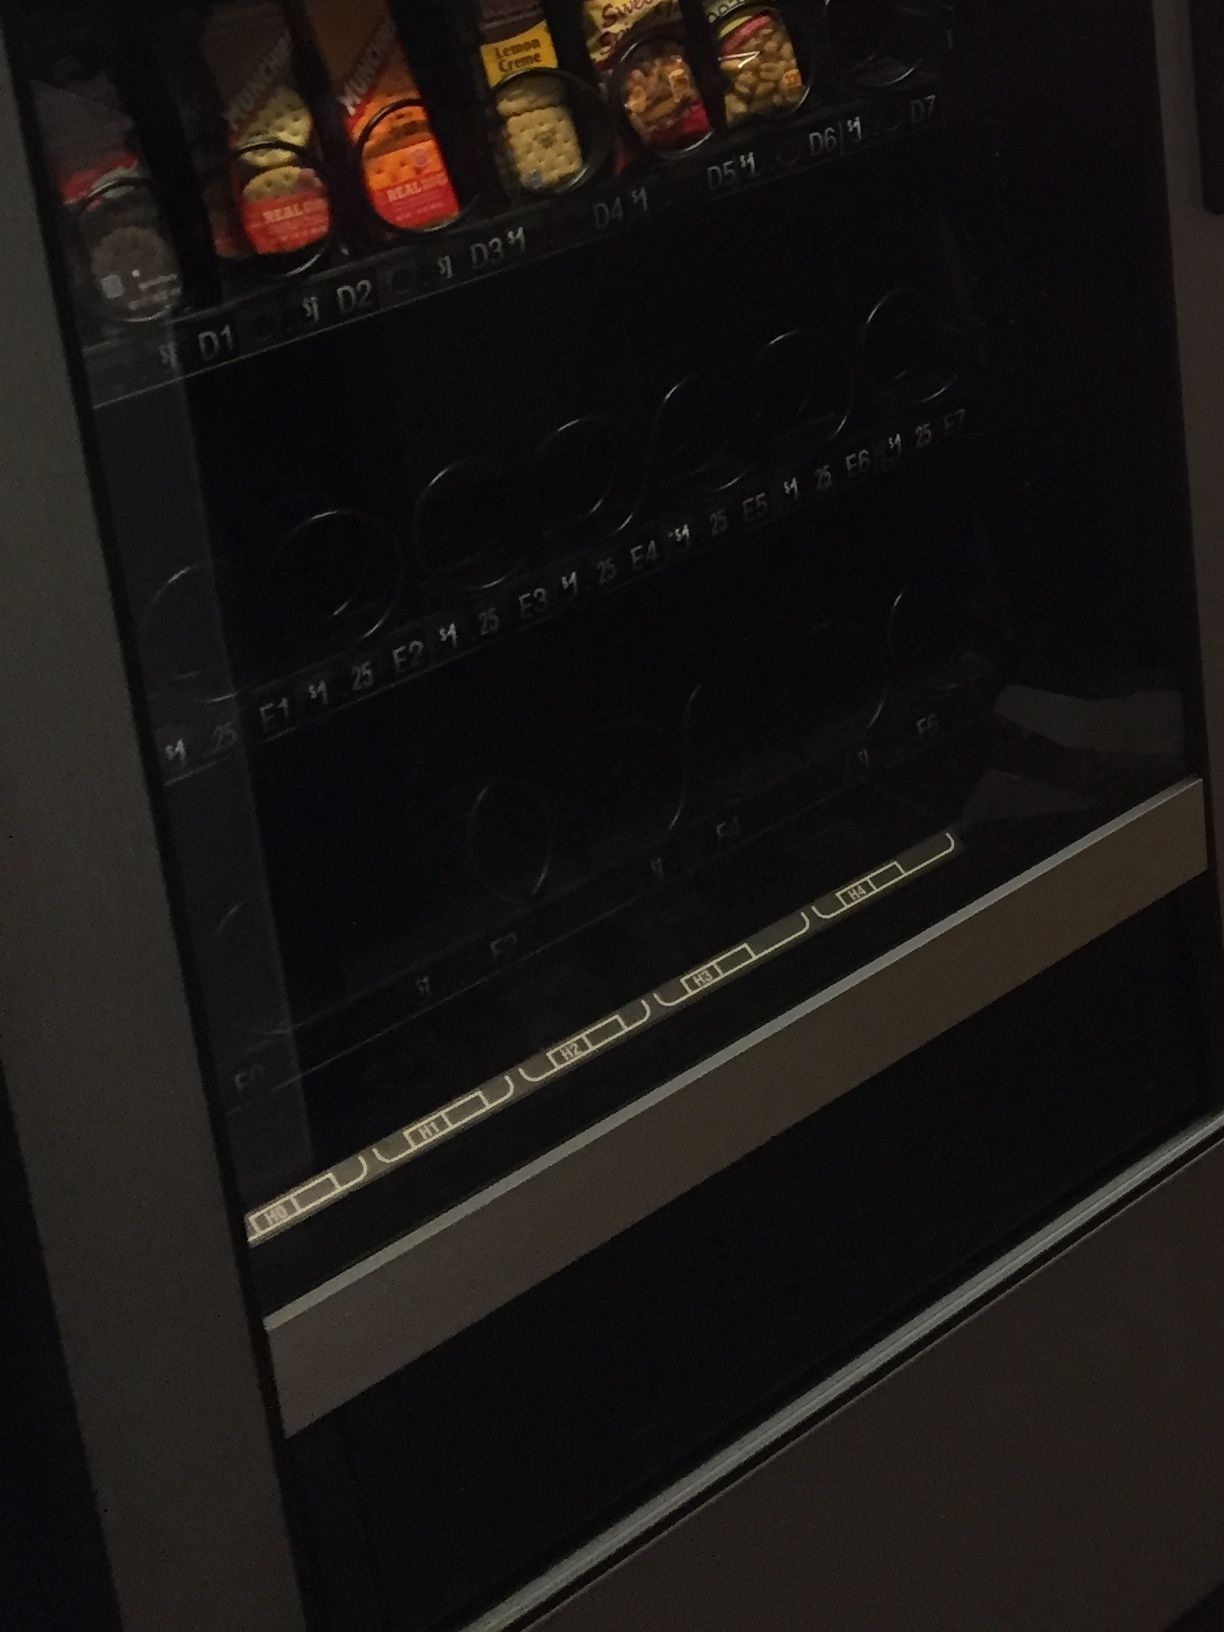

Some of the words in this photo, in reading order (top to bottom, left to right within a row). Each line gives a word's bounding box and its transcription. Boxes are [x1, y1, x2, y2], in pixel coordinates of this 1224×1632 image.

[494, 37, 541, 59] Lemon
[497, 52, 542, 74] Creme
[808, 126, 837, 157] D6
[706, 159, 737, 190] D5
[592, 195, 624, 229] D4
[469, 236, 505, 271] D3
[336, 279, 373, 315] D2
[848, 884, 868, 904] H4
[693, 968, 715, 988] H3
[560, 1040, 584, 1062] H2
[418, 1118, 441, 1139] H1
